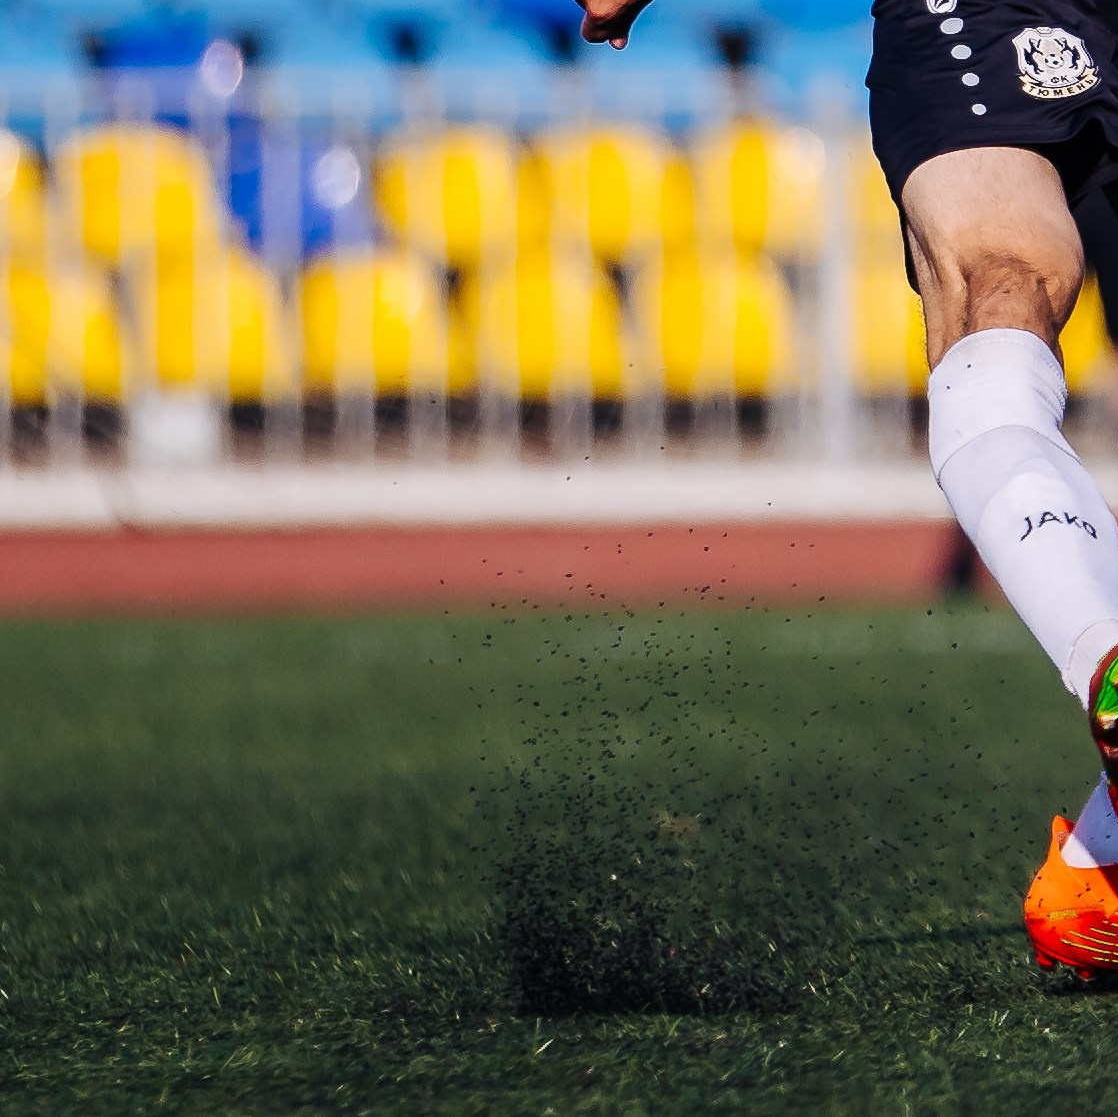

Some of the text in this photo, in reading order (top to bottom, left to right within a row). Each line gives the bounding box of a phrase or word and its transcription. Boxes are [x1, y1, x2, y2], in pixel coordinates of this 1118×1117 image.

[1028, 78, 1094, 97] ТЮМЕНЬ
[1050, 75, 1070, 84] ФК
[1020, 511, 1098, 542] JAKO
